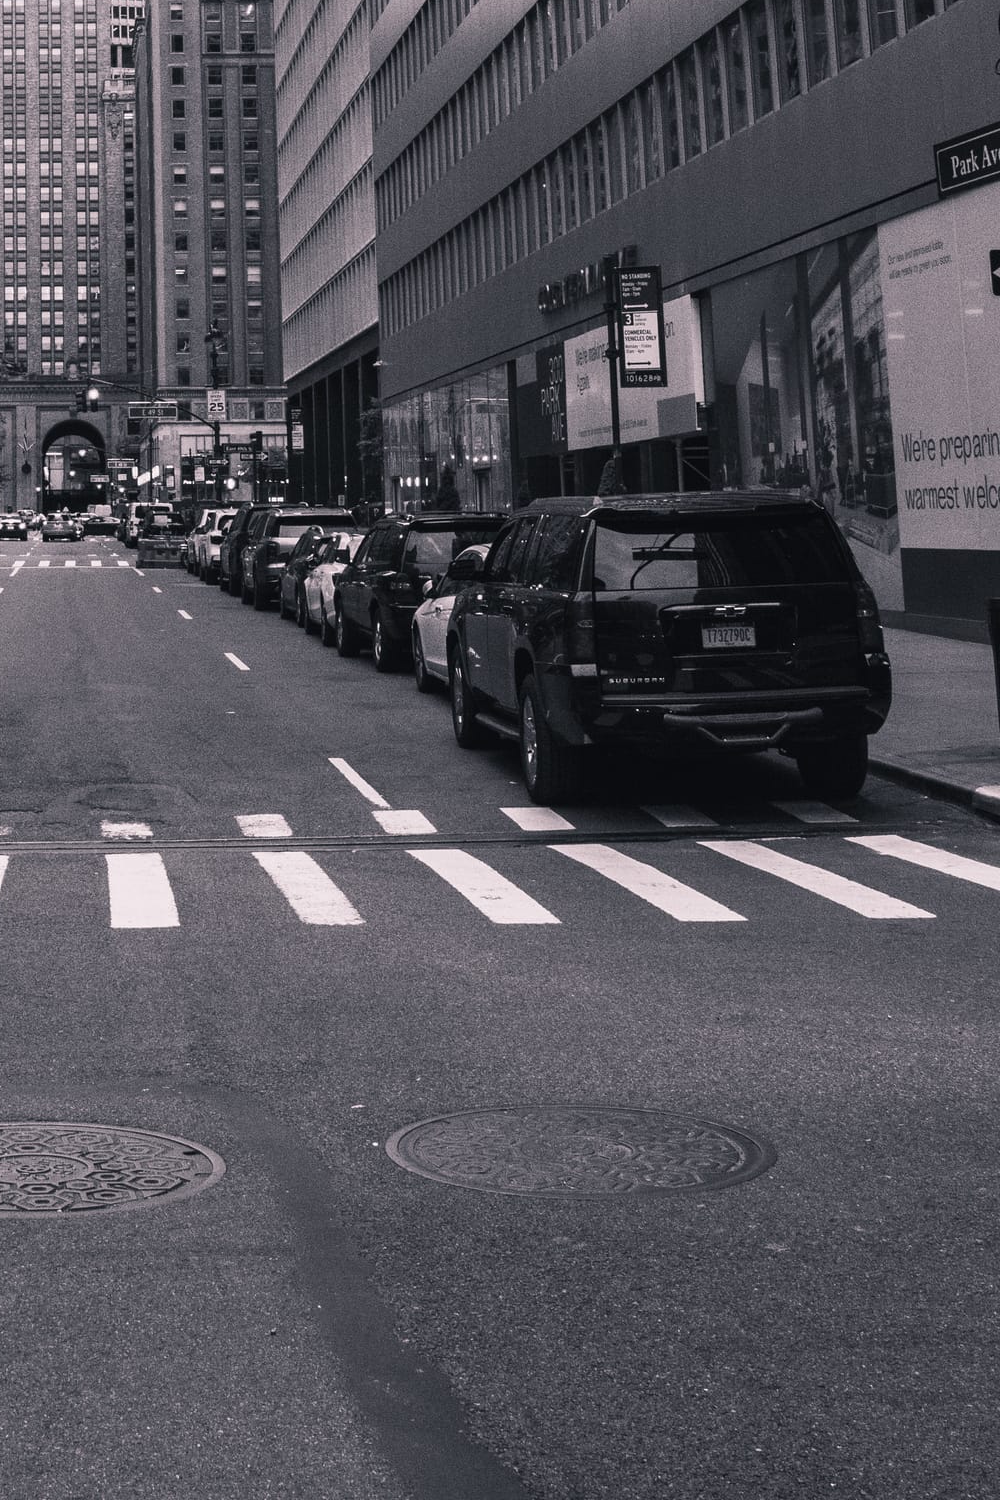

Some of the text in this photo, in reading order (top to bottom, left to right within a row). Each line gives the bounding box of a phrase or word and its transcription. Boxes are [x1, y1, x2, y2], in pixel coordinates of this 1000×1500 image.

[950, 150, 980, 179] Park
[628, 272, 651, 280] STANDING
[625, 314, 632, 325] 3
[548, 355, 564, 386] 300
[209, 402, 224, 412] 25
[541, 386, 561, 417] PARK
[551, 413, 566, 443] AVE
[901, 430, 936, 462] We're
[905, 478, 960, 510] warmest
[608, 677, 665, 685] SUBURBAN
